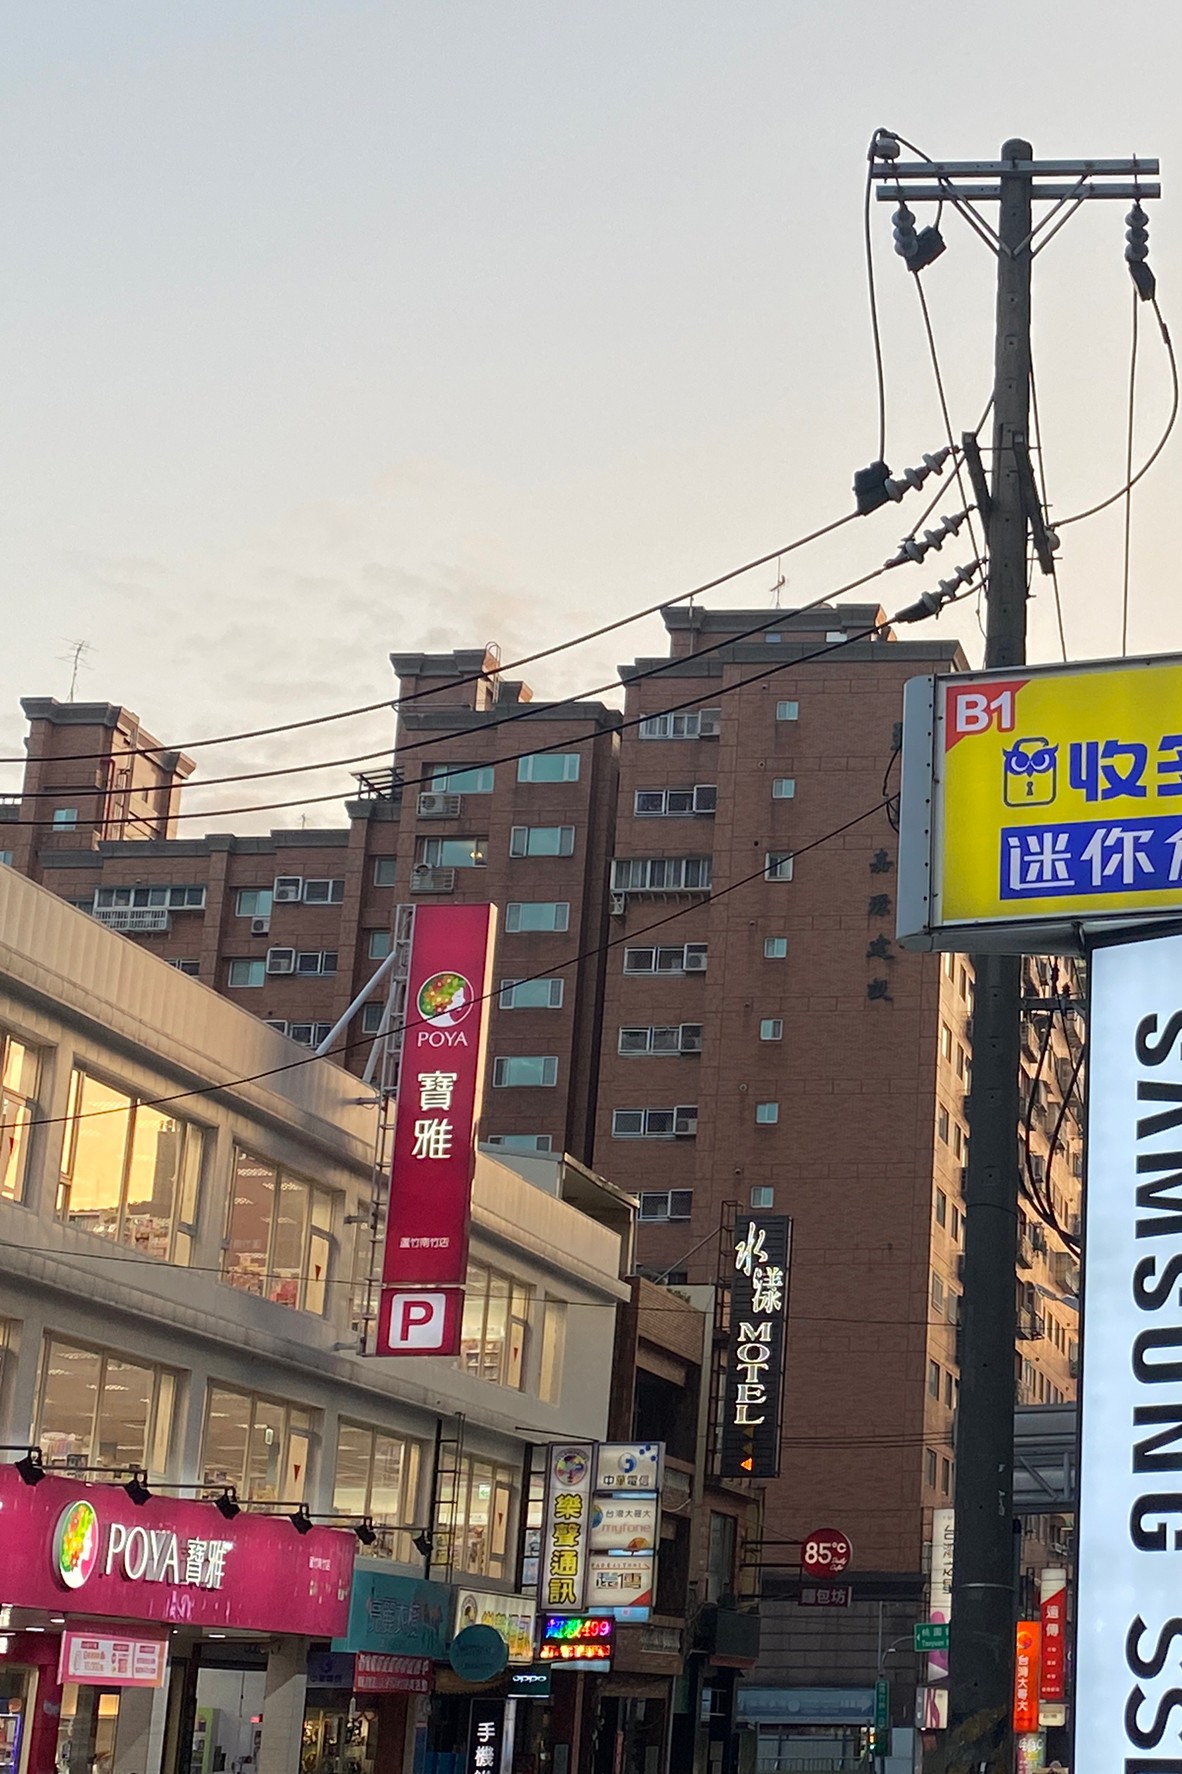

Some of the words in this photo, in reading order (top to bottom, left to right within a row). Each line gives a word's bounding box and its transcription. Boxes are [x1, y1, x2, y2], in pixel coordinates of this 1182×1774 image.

[955, 690, 1015, 733] B1
[417, 1031, 468, 1048] POYA
[411, 1070, 457, 1160] 寶雅
[735, 1221, 784, 1314] 水漾
[400, 1300, 434, 1342] P
[734, 1321, 773, 1425] MOTEL
[603, 1475, 650, 1487] 中華電信
[601, 1522, 651, 1535] myfone
[605, 1508, 652, 1519] 台灣大哥大
[106, 1522, 180, 1585] POYA
[184, 1537, 226, 1591] 寶雅
[548, 1494, 583, 1606] 樂聲通訊
